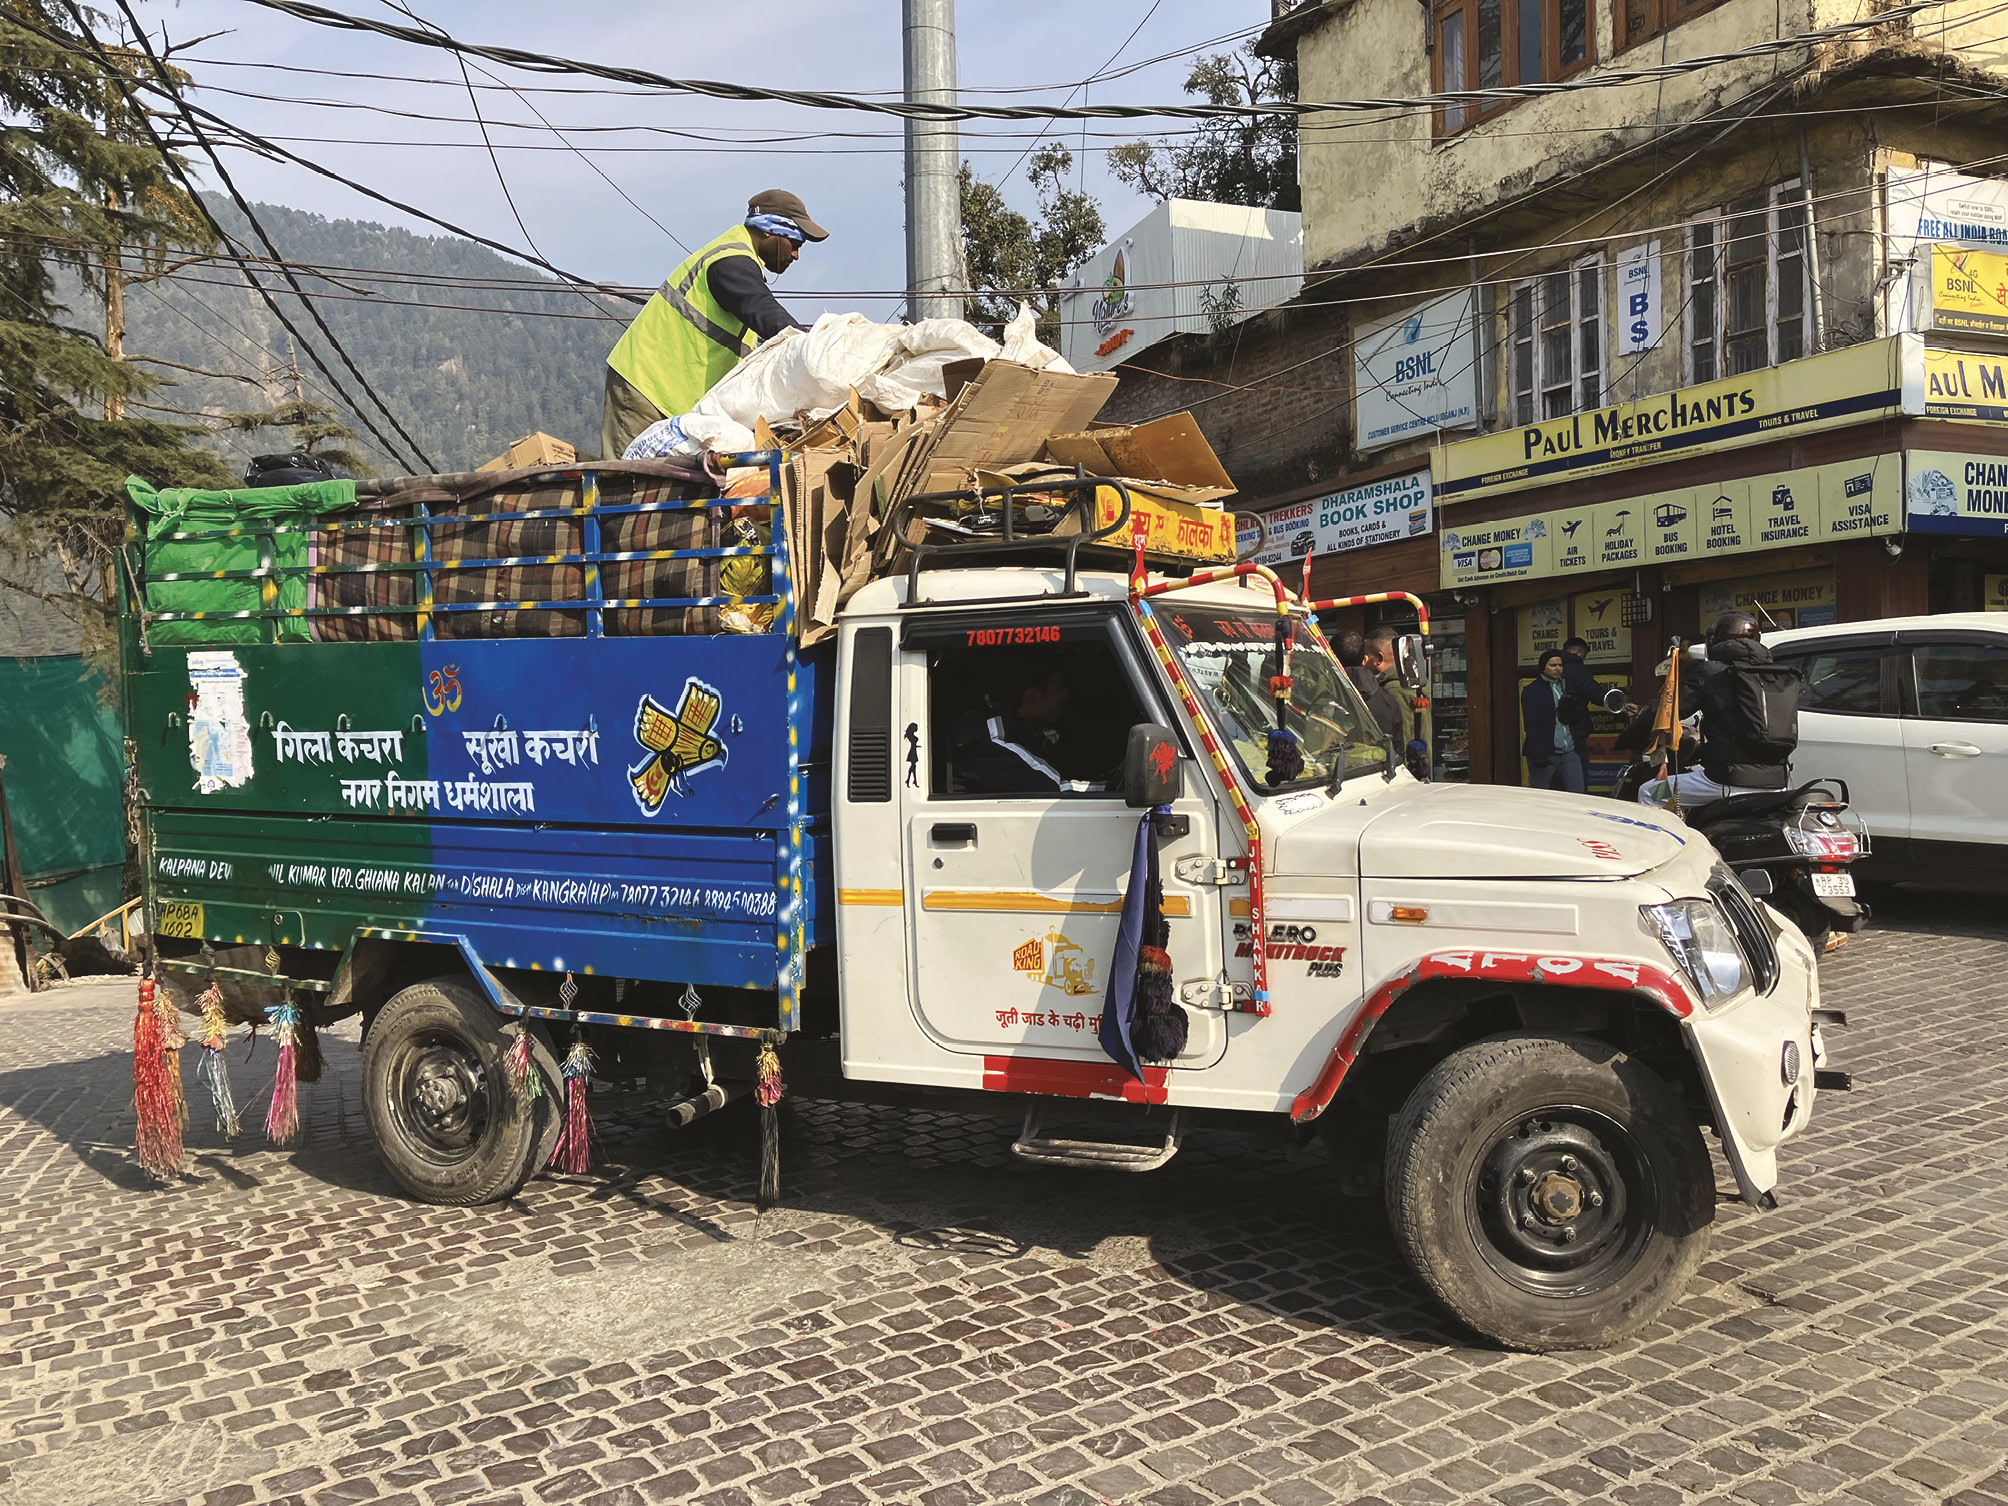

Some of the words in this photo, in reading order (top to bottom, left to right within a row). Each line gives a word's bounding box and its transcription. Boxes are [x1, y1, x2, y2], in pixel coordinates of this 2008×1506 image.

[1919, 218, 1941, 238] FREE
[1943, 222, 1959, 239] ALL
[1960, 224, 1987, 240] INDIA
[1628, 264, 1648, 279] BSNL
[1946, 277, 1978, 294] BSNL
[1395, 351, 1437, 383] BSNL
[1930, 360, 1972, 397] AUL
[1758, 416, 1782, 429] TOURS
[1783, 415, 1790, 424] &
[1791, 409, 1819, 422] TRAVEL
[1390, 422, 1409, 434] SERVICE
[1631, 441, 1662, 455] TRANFER
[1481, 474, 1502, 485] FOREIGN
[1502, 468, 1529, 479] EXCHANGE
[1322, 476, 1420, 511] DHARAMSHALA
[1269, 503, 1314, 525] TREKKERS
[1320, 503, 1367, 528] BOOK
[1374, 490, 1425, 515] SHOP
[1848, 503, 1871, 517] VISA
[1273, 524, 1284, 534] BUS
[1285, 519, 1310, 531] BOOKING
[1339, 526, 1360, 538] BOOKS,
[1361, 521, 1380, 534] CARDS
[1381, 520, 1387, 529] &
[1710, 524, 1736, 536] HOTEL
[1768, 515, 1801, 528] TRAVEL
[1831, 514, 1889, 533] ASSISTANCE
[1327, 542, 1337, 552] ALL
[1338, 539, 1355, 550] KINDS
[1356, 537, 1364, 546] OF
[1365, 529, 1401, 544] STATIONERY
[1461, 533, 1491, 547] CHANGE
[1493, 528, 1521, 542] MONEY
[1663, 532, 1678, 543] BUS
[1706, 535, 1741, 549] BOOKING
[1761, 526, 1809, 542] INSURANCE
[1566, 546, 1578, 556] AIR
[1604, 538, 1634, 551] HOLIDAY
[1655, 544, 1688, 556] BOOKING
[1456, 557, 1473, 568] VISA
[1560, 556, 1586, 568] TICKETS
[1602, 549, 1638, 562] PACKAGES
[1735, 590, 1778, 607] CHANGE
[1782, 586, 1823, 603] MONEY
[966, 626, 1060, 646] 7807732146
[1532, 629, 1559, 640] CHANGE
[1585, 628, 1609, 639] TOURS
[1611, 627, 1617, 637] &
[1534, 641, 1558, 652] MONEY
[1588, 640, 1616, 652] TRAVEL
[334, 730, 405, 766] कचरा
[522, 730, 600, 771] कचरा
[340, 779, 383, 810] नगर
[383, 770, 440, 811] निगम
[443, 771, 536, 816] धर्मशाला
[158, 857, 206, 878] KALPANA
[288, 865, 327, 888] KUMAR
[403, 871, 446, 894] KALAN
[1248, 846, 1258, 889] JAI
[1820, 875, 1832, 885] HP
[1837, 875, 1849, 886] 39
[1821, 884, 1850, 895] F3553
[160, 903, 198, 920] HP68A
[1014, 941, 1040, 960] ROAD
[1234, 942, 1347, 962] MXITRUCK
[1015, 954, 1042, 971] KING
[1306, 962, 1343, 978] PLUS
[1047, 1009, 1060, 1027] के
